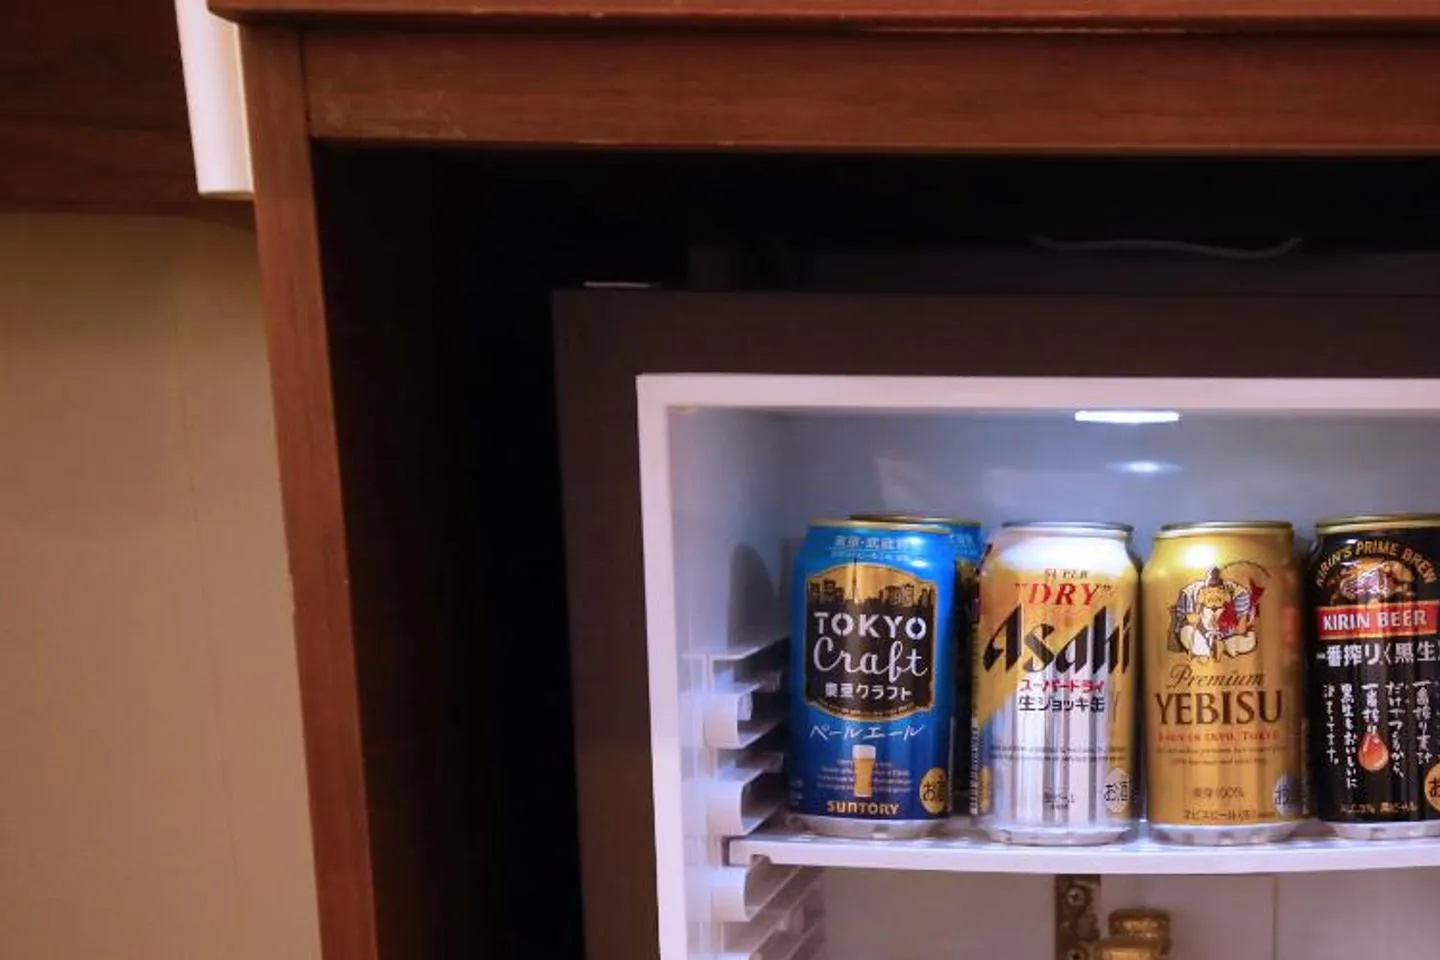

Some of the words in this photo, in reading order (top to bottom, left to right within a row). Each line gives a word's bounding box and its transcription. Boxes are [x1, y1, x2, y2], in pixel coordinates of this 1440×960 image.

[1356, 541, 1399, 556] PRIME
[813, 612, 927, 640] TOKYO
[1323, 614, 1371, 631] KIRIN
[1376, 610, 1427, 628] BEER
[983, 604, 1131, 674] Asahi
[813, 636, 928, 683] Craft
[1020, 679, 1104, 693] スーパードライ
[1166, 664, 1265, 691] Premium
[1019, 696, 1105, 712] 生ジョッキ缶
[1155, 690, 1283, 725] YEBISU
[809, 724, 924, 741] ペールエール
